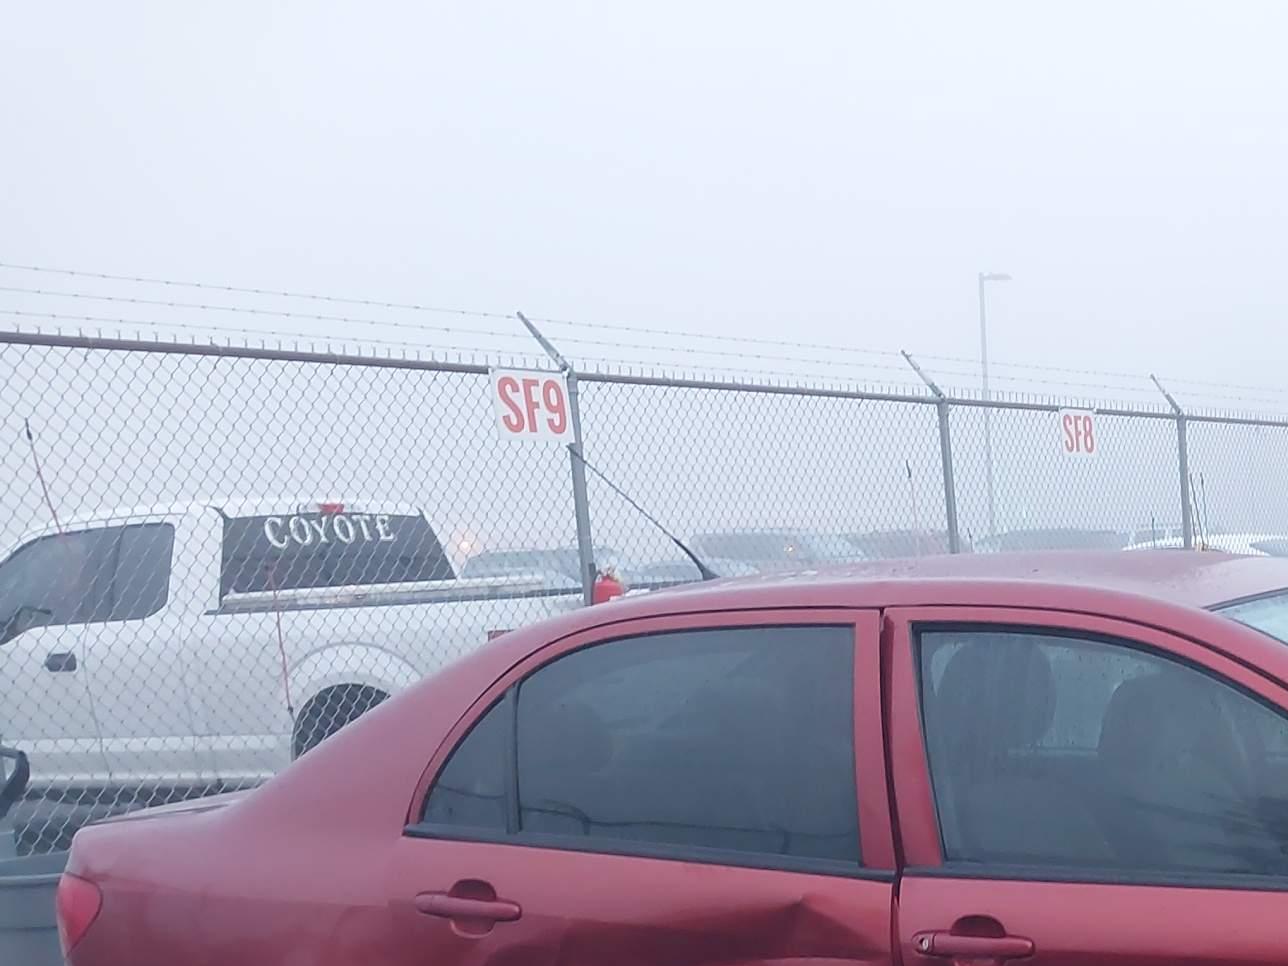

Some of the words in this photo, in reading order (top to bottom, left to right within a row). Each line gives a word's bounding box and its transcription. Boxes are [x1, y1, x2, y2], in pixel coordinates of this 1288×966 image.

[497, 376, 567, 435] SF9
[1062, 414, 1095, 454] SF8
[263, 514, 395, 549] COYOTE
